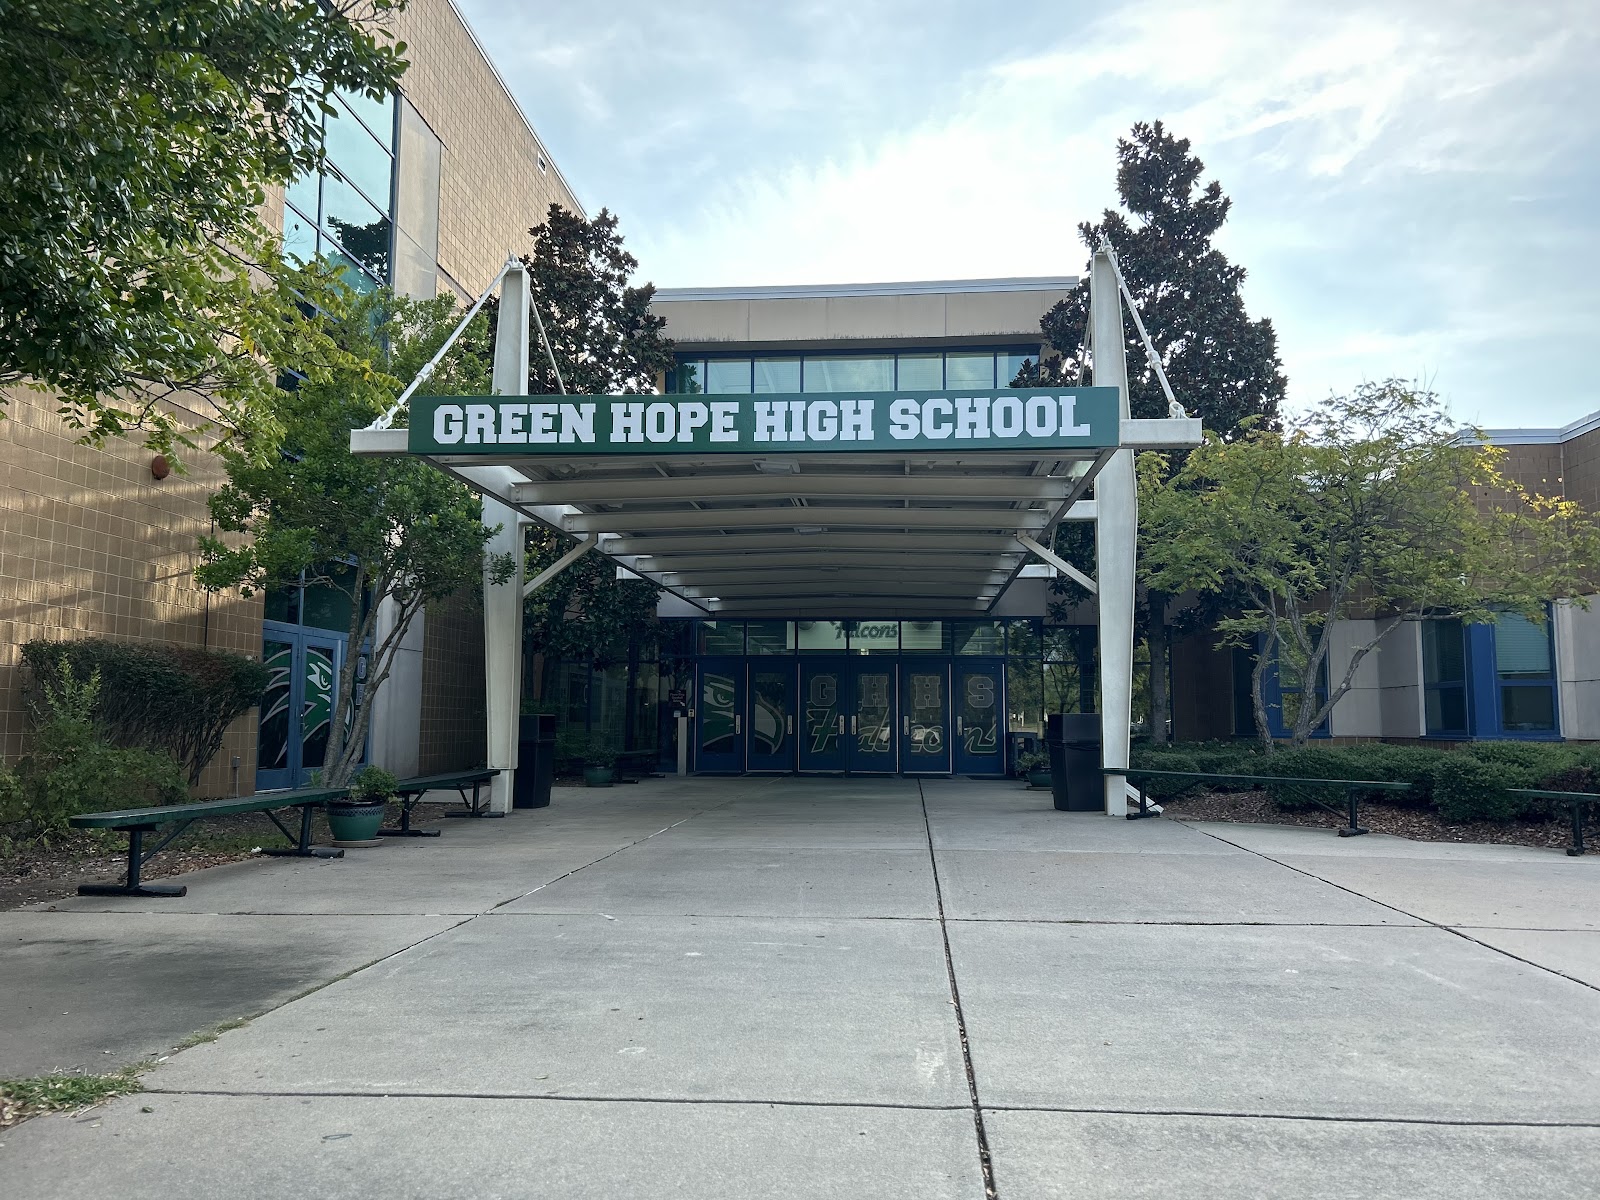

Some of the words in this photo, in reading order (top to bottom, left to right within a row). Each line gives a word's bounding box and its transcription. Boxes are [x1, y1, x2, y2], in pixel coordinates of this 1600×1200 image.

[433, 403, 596, 444] GREEN
[609, 402, 739, 443] HOPE
[753, 400, 874, 442] HIGH
[889, 395, 1091, 440] SCHOOL
